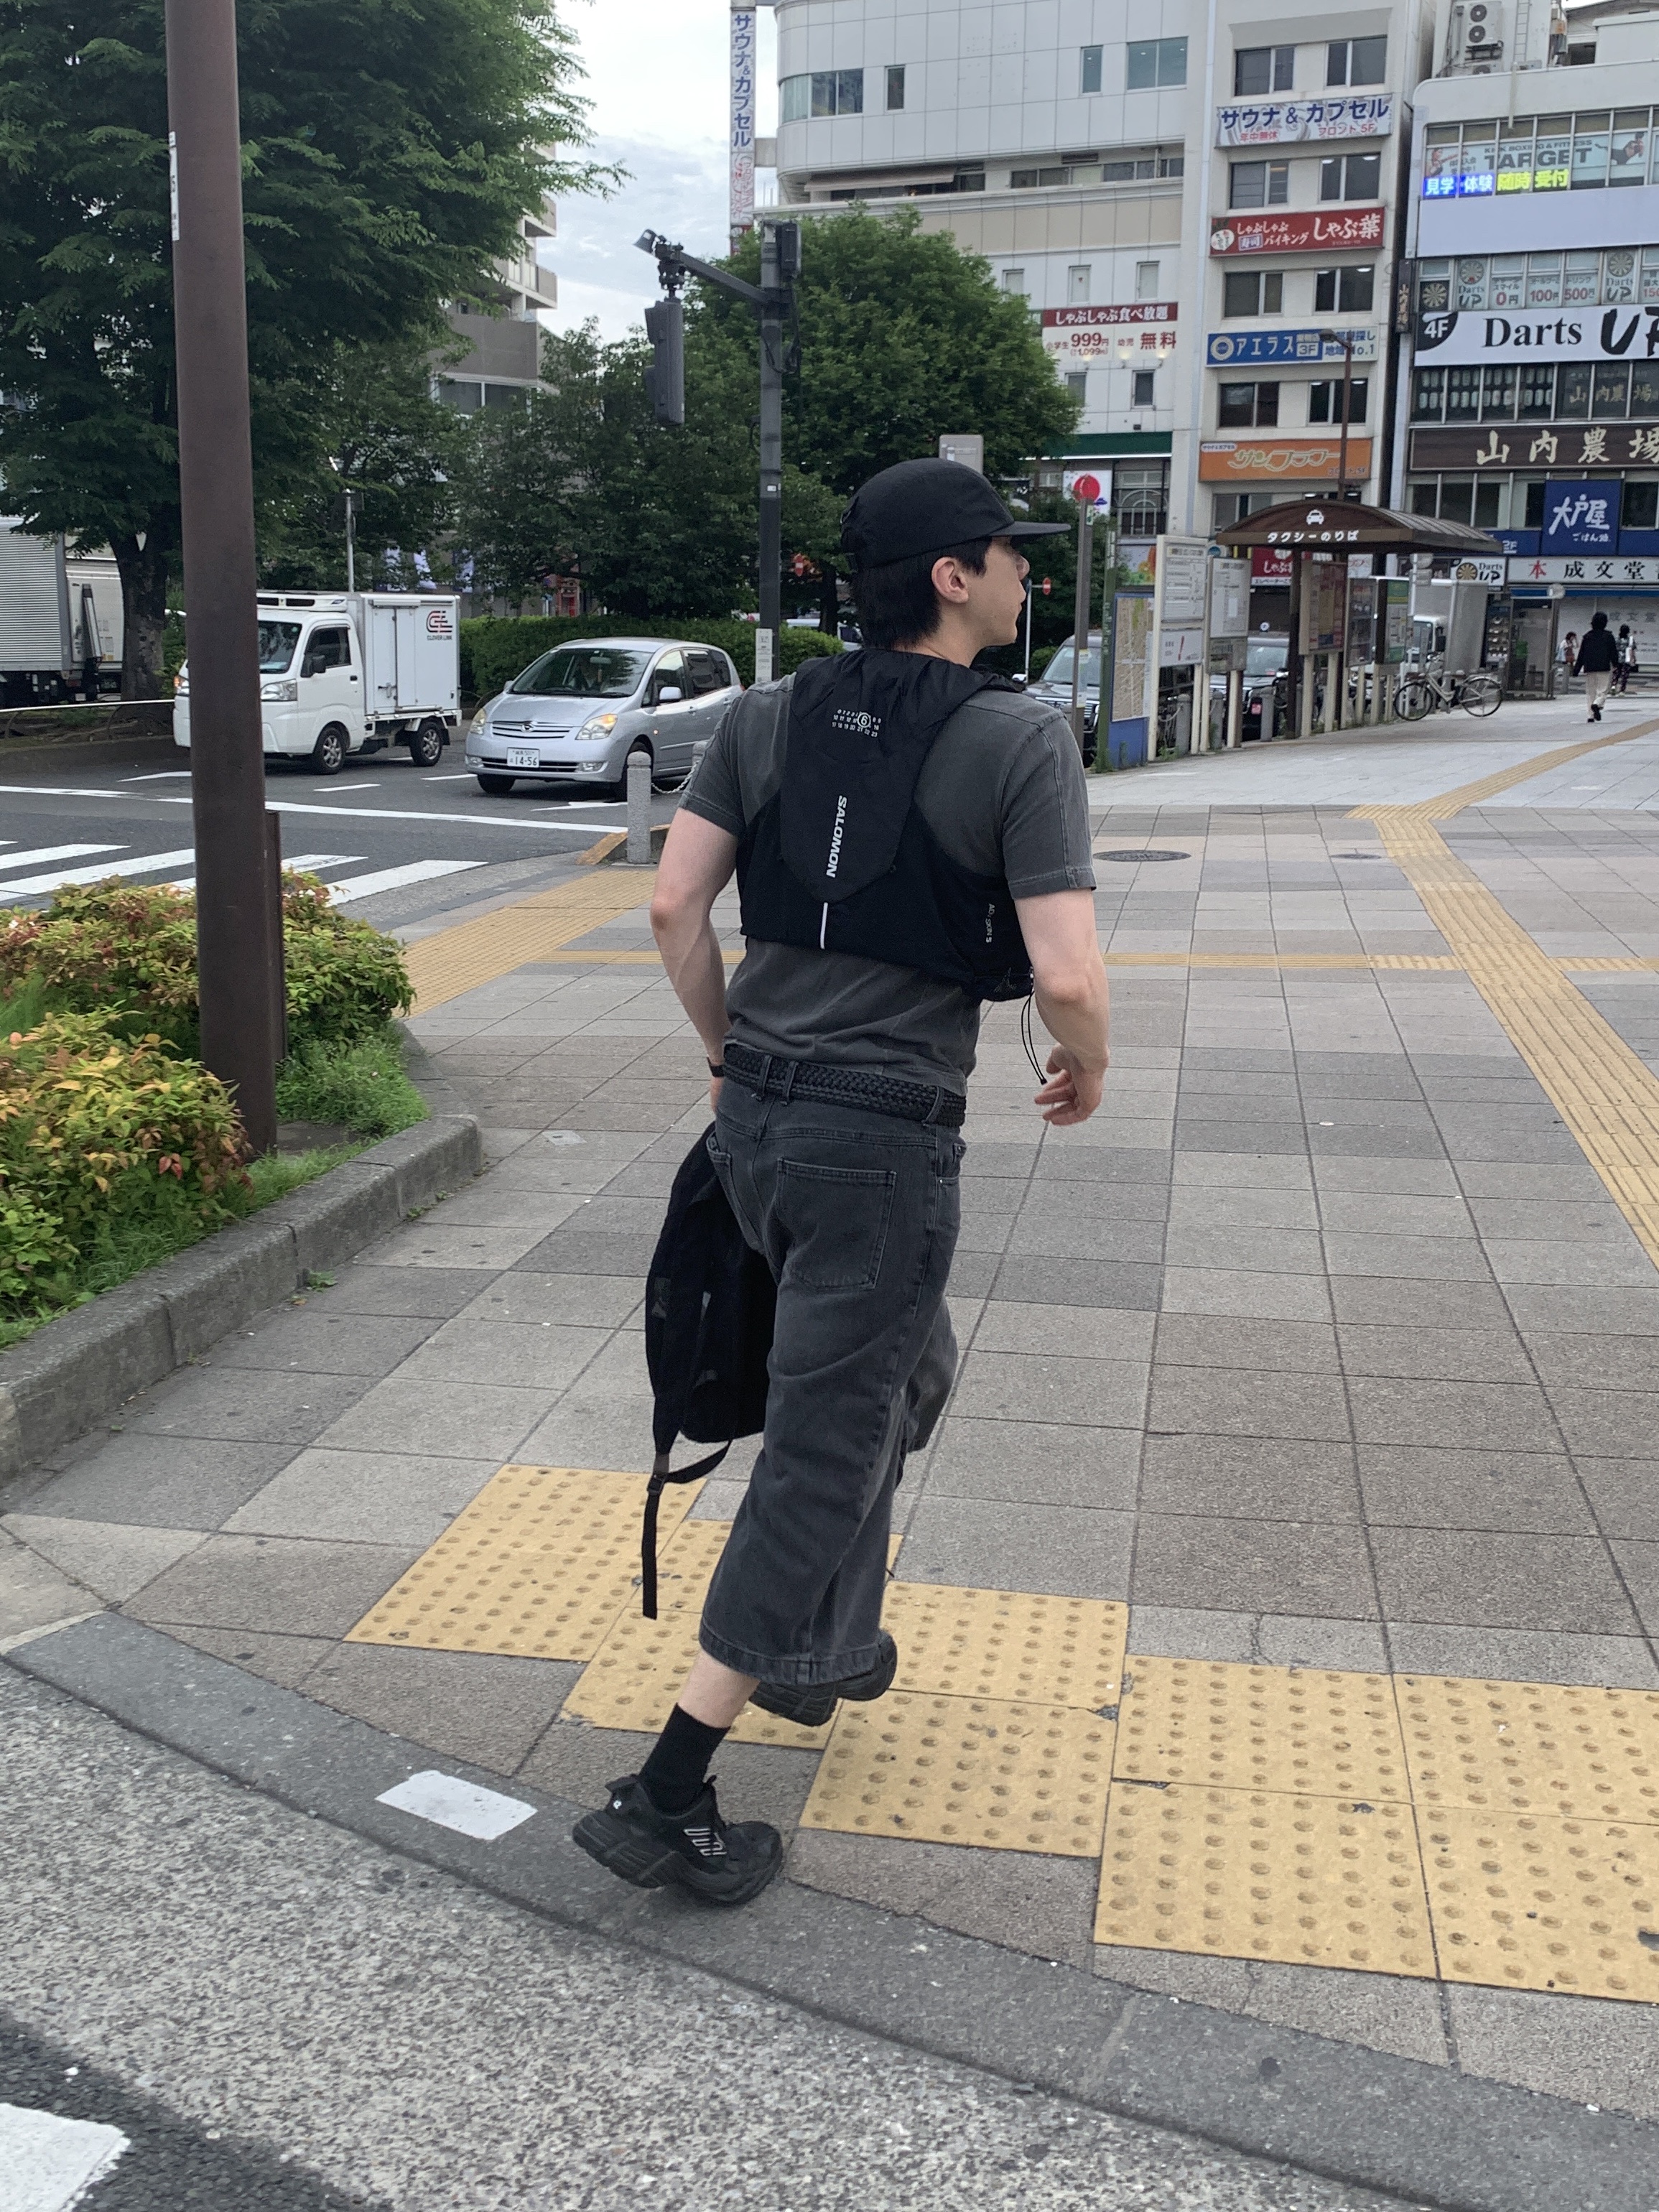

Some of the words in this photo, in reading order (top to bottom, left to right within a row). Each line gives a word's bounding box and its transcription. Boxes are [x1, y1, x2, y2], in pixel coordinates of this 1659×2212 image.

[1484, 148, 1592, 170] TARGET
[1237, 220, 1289, 235] しゃぶしゃぶ
[1314, 213, 1380, 241] しゃぶ葉
[1264, 231, 1309, 246] バイキング
[1459, 294, 1482, 309] UP
[1607, 287, 1631, 302] UP
[1056, 305, 1168, 325] しゃぶしゃぶ食べ放題
[1140, 331, 1176, 349] 無料
[1424, 320, 1449, 339] 4F
[1482, 317, 1582, 348] Darts
[1236, 336, 1293, 356] アエラス
[1299, 345, 1316, 355] 3F
[1477, 427, 1659, 465] 山内農場
[1548, 493, 1610, 535] 大戸屋
[1267, 530, 1360, 544] タクシーのりば
[1529, 560, 1546, 579] 本
[1563, 561, 1659, 580] 成文堂
[861, 715, 868, 725] 6
[515, 756, 537, 766] 14-56
[826, 795, 847, 878] SALOMON
